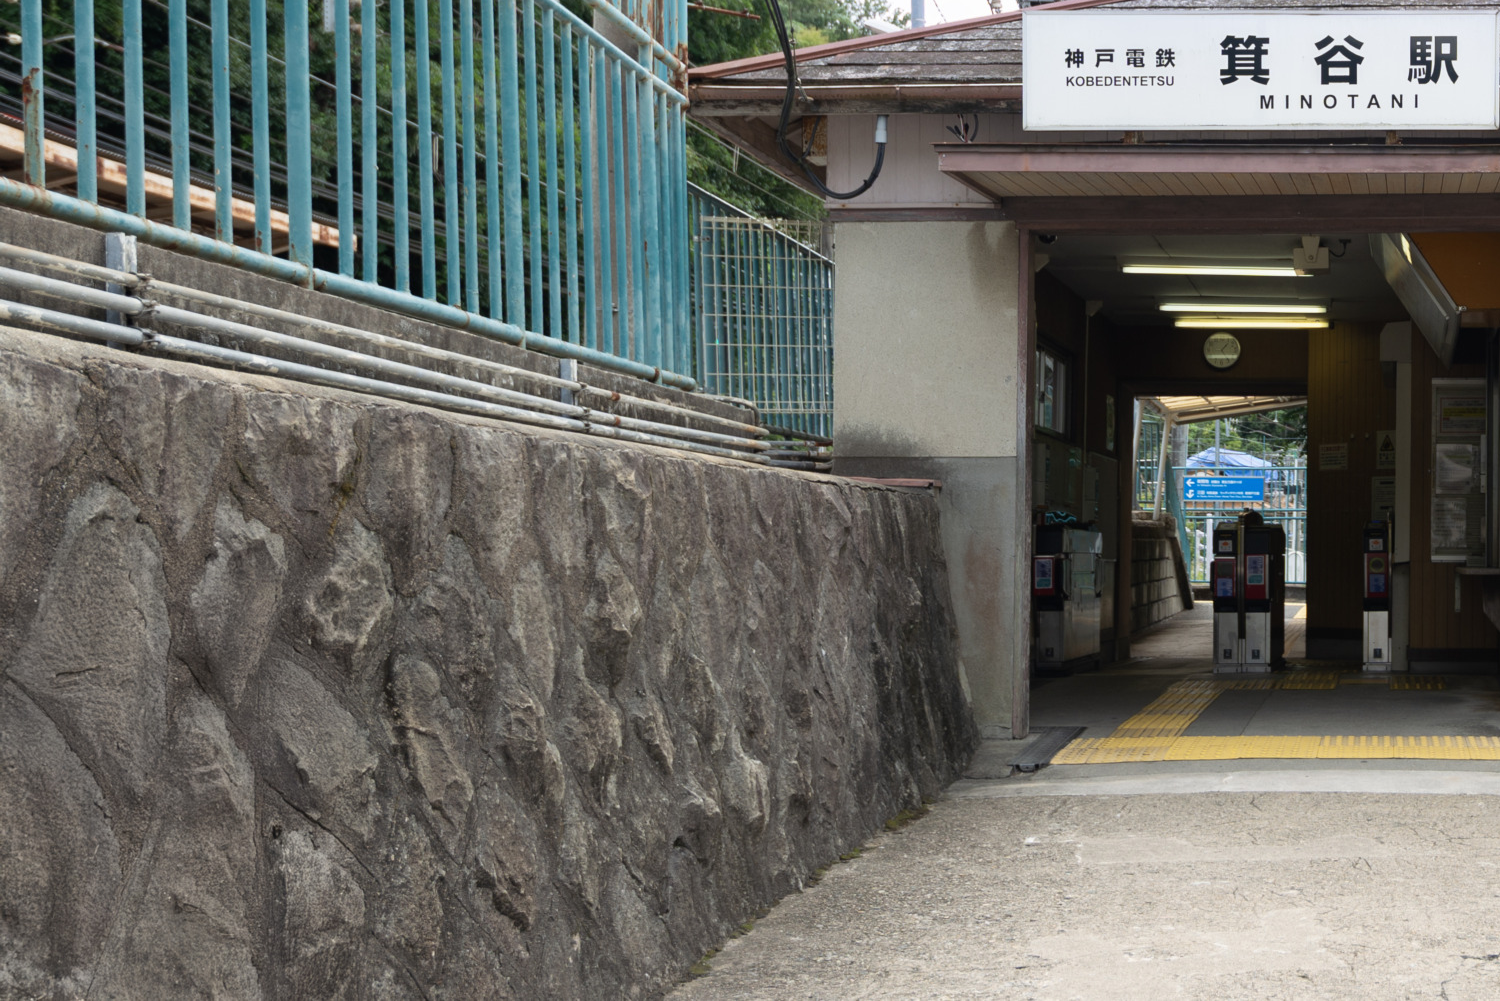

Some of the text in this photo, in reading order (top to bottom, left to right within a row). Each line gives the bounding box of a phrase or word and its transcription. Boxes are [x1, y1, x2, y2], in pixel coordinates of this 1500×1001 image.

[1064, 48, 1176, 68] 神戸電鉄
[1219, 35, 1459, 85] 箕谷駅
[1066, 76, 1175, 87] KOBEDENTETSU
[1259, 94, 1419, 109] MINOTANI
